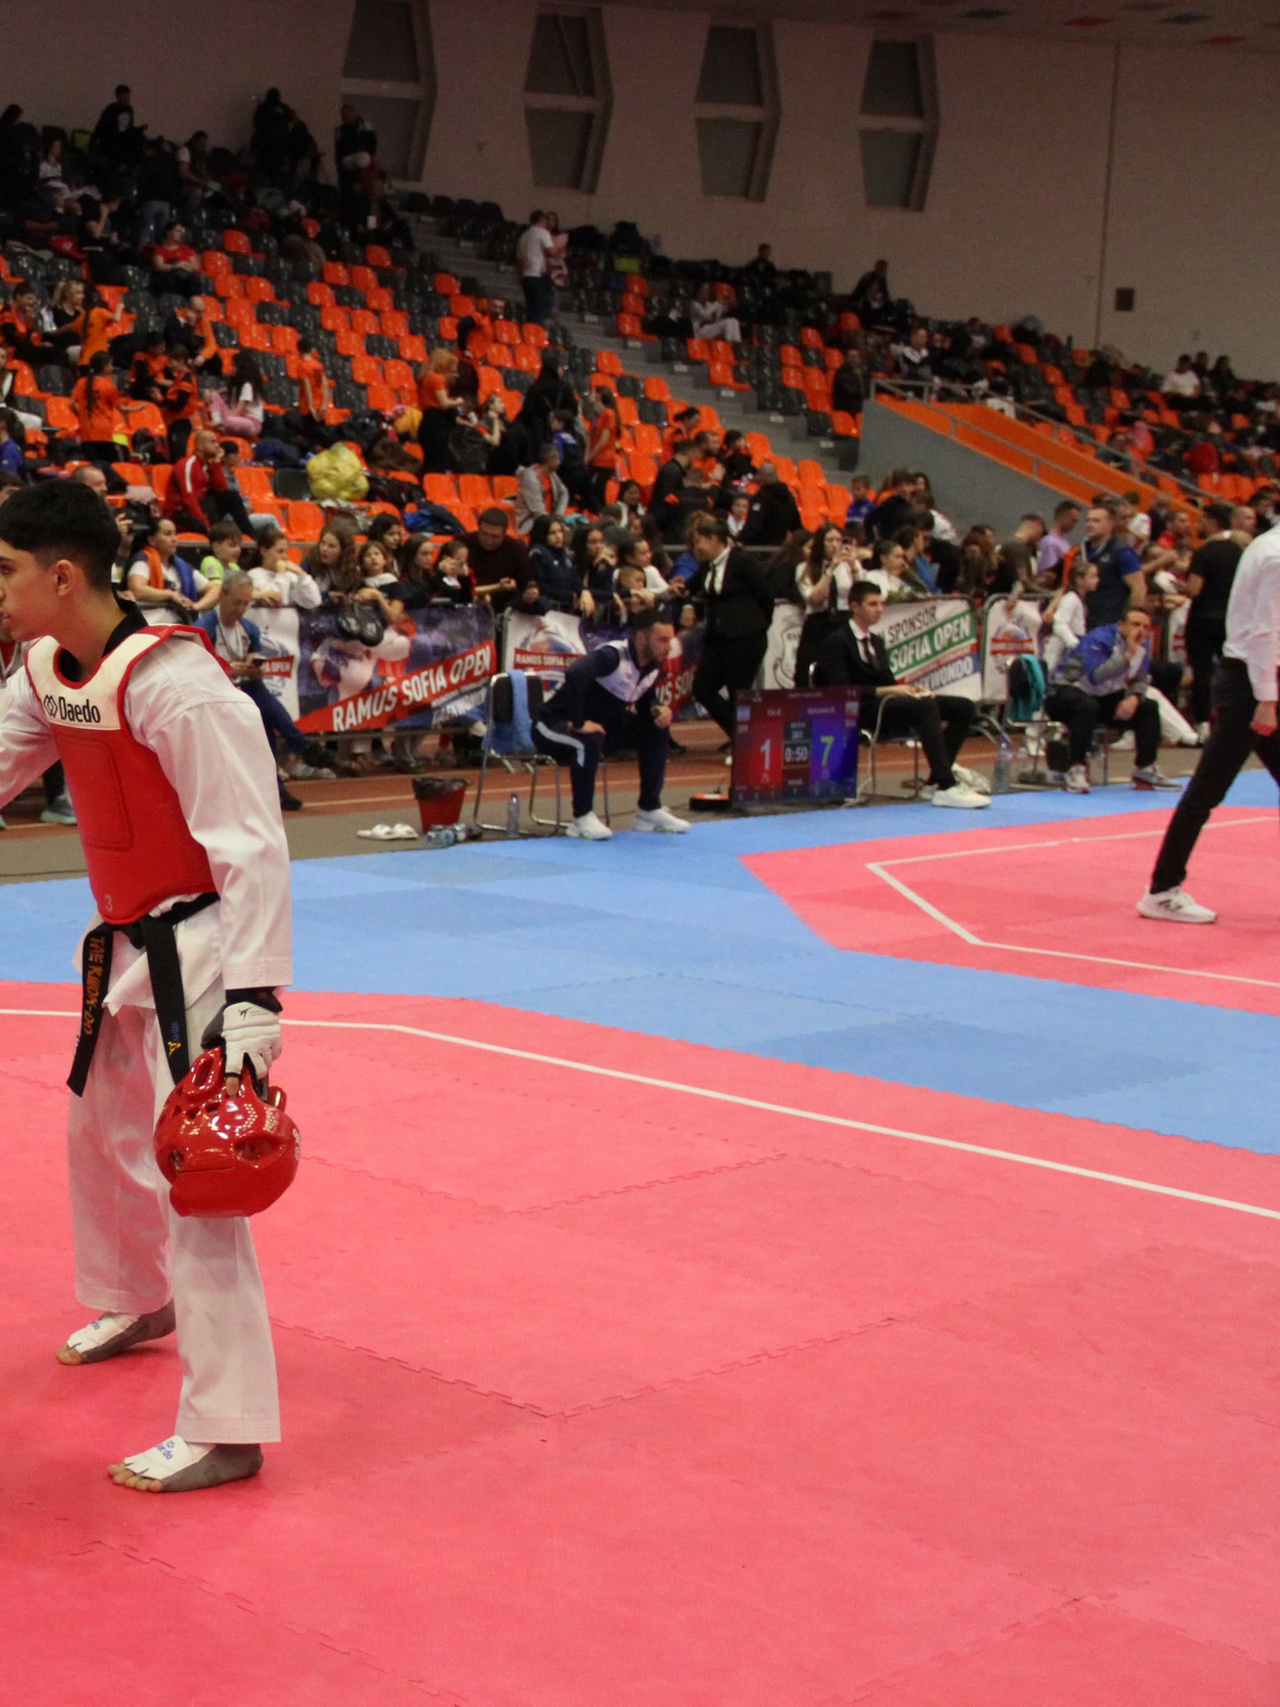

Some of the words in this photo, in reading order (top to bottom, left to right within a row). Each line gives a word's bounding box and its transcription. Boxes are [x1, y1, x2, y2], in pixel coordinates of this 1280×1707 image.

[888, 605, 937, 644] SPONSOR
[890, 637, 932, 672] SOFIA
[934, 615, 970, 651] OPEN
[516, 653, 541, 665] RAMUS
[543, 654, 564, 666] SOFIA
[333, 685, 398, 732] RAMUS
[401, 667, 447, 706] SOFIA
[450, 645, 491, 682] OPEN
[58, 696, 101, 723] Daedo
[761, 739, 771, 770] 1
[785, 746, 808, 763] 0:50
[820, 736, 834, 766] 7
[88, 936, 106, 963] TAE
